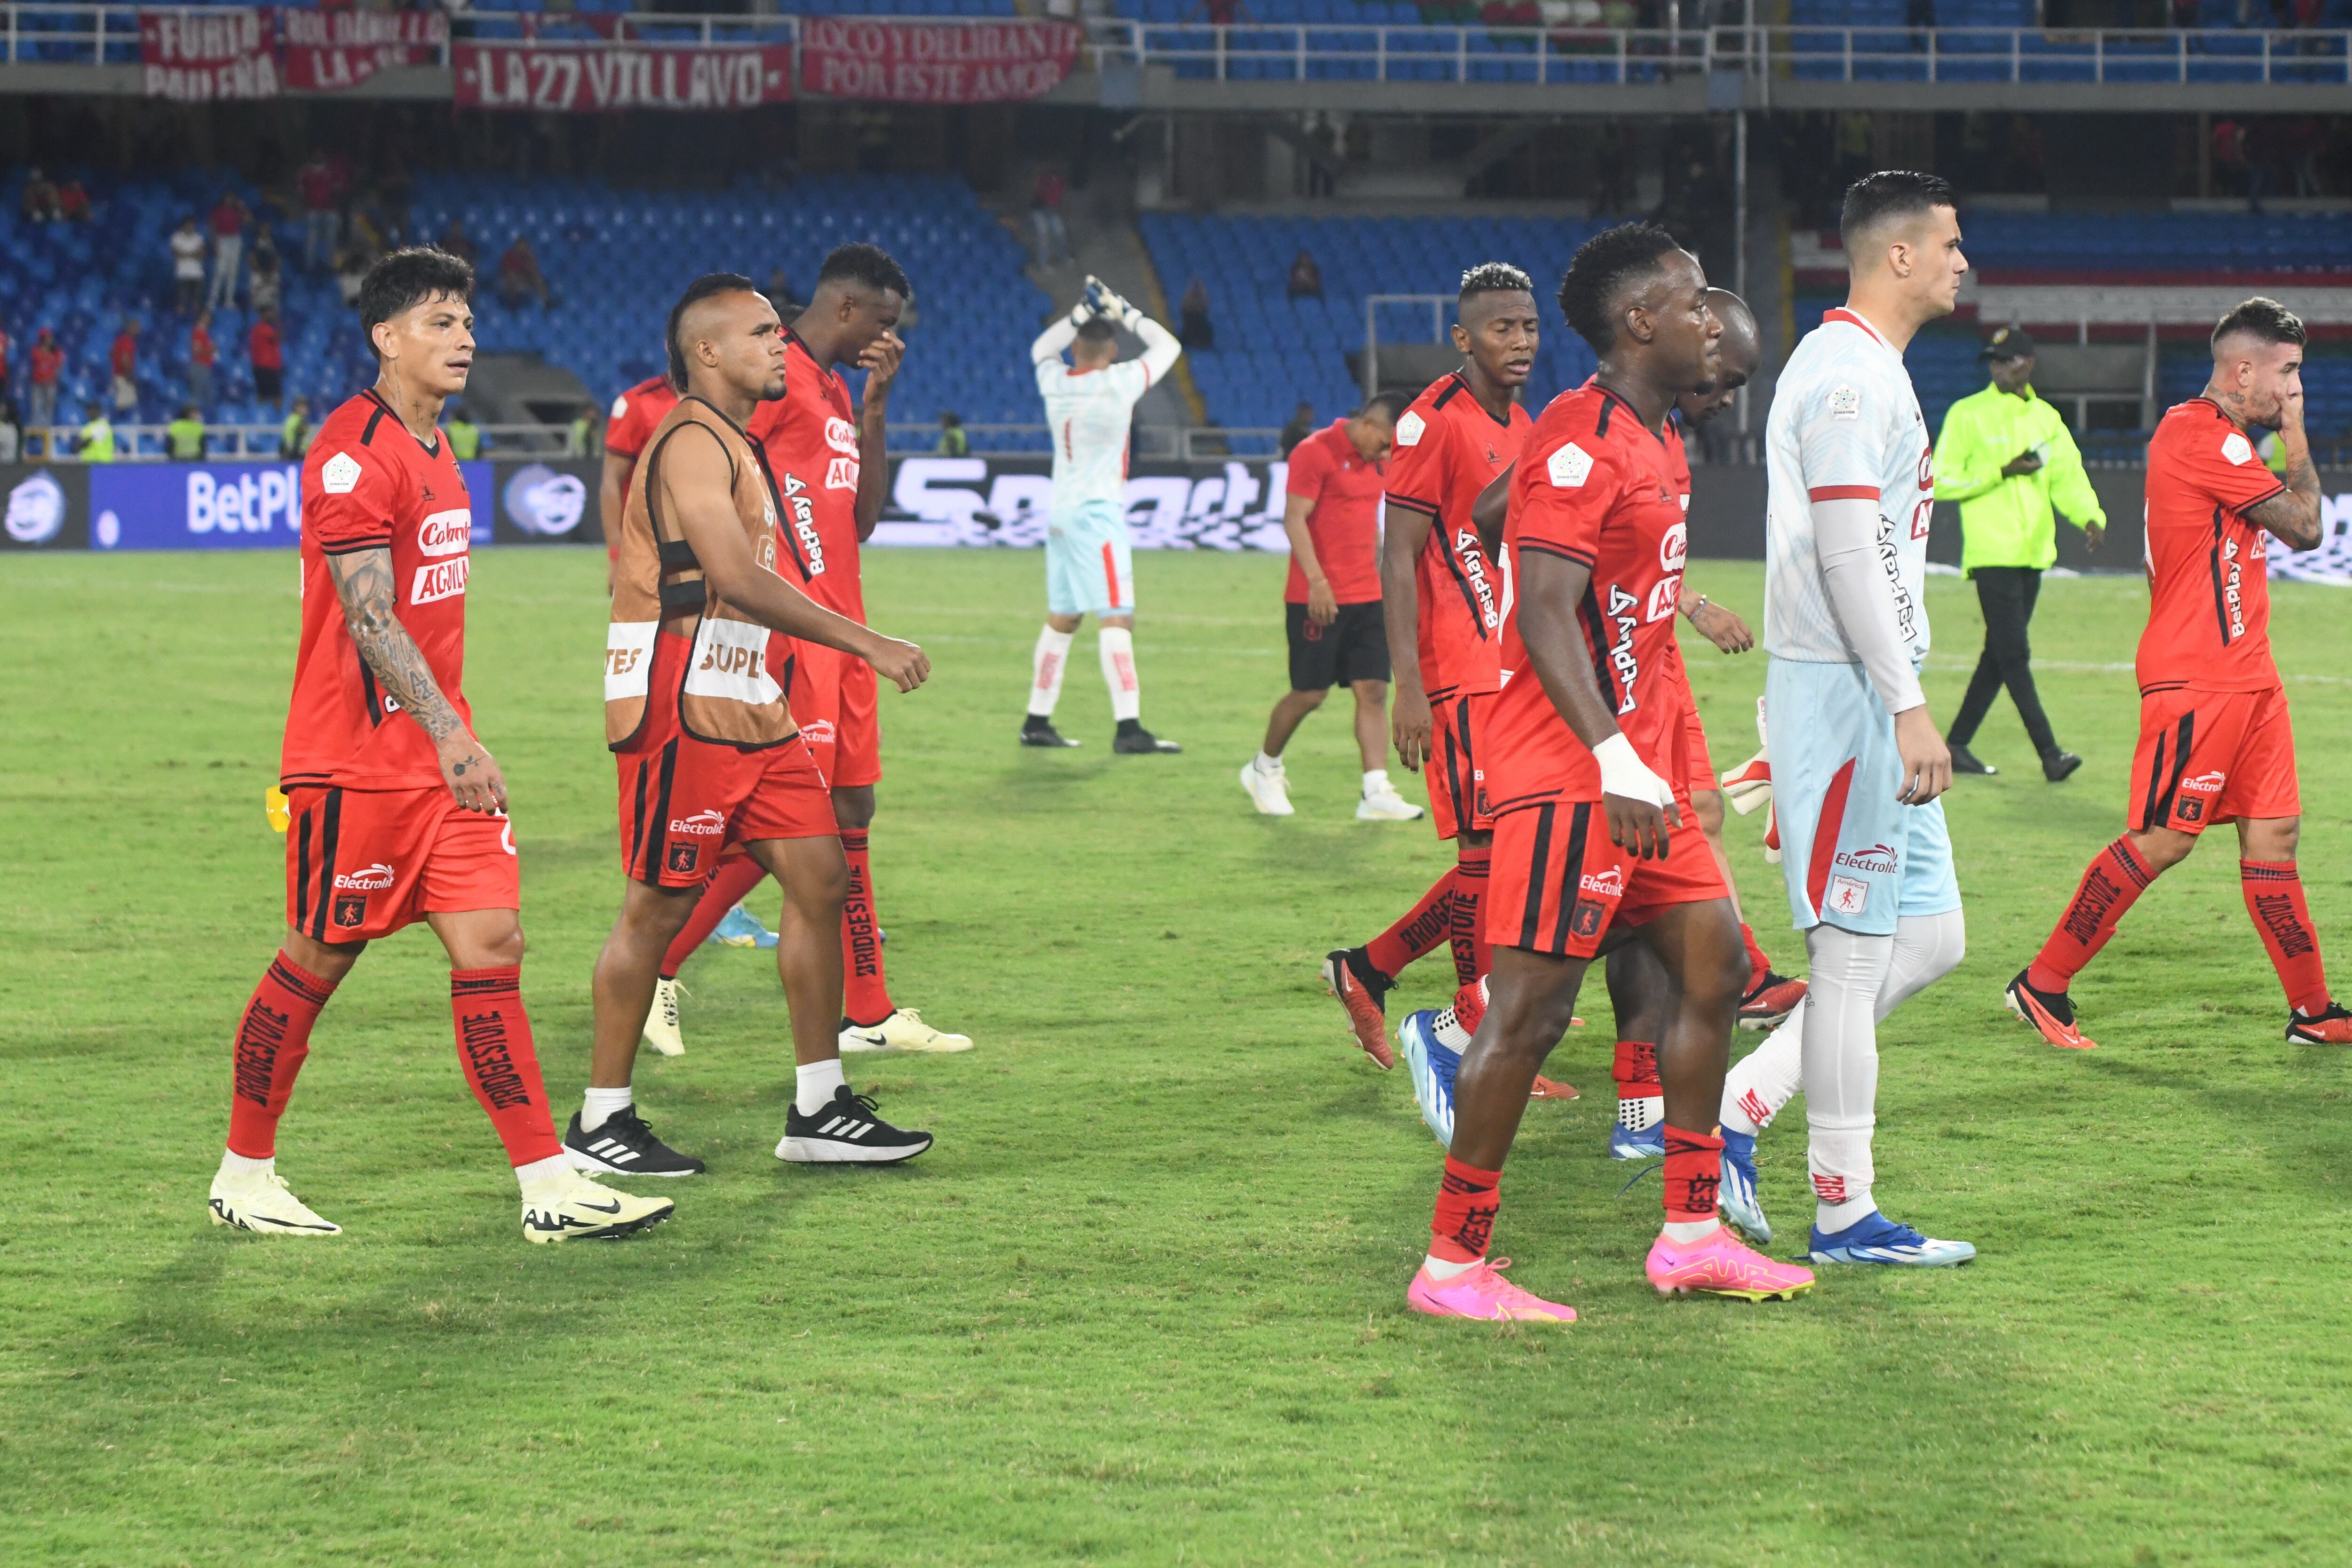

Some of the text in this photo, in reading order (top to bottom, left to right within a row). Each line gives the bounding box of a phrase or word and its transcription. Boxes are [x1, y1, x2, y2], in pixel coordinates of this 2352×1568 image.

[585, 51, 763, 109] VILLAVO
[823, 56, 892, 95] POR
[187, 465, 302, 533] BetPl
[792, 496, 825, 575] BetPlay
[1462, 548, 1498, 629] BetPlay
[2225, 561, 2245, 637] BetPlay
[669, 820, 725, 835] Electrolit
[334, 874, 394, 890] Electrolit
[1836, 852, 1897, 873] Electrolit
[1837, 878, 1865, 890] América
